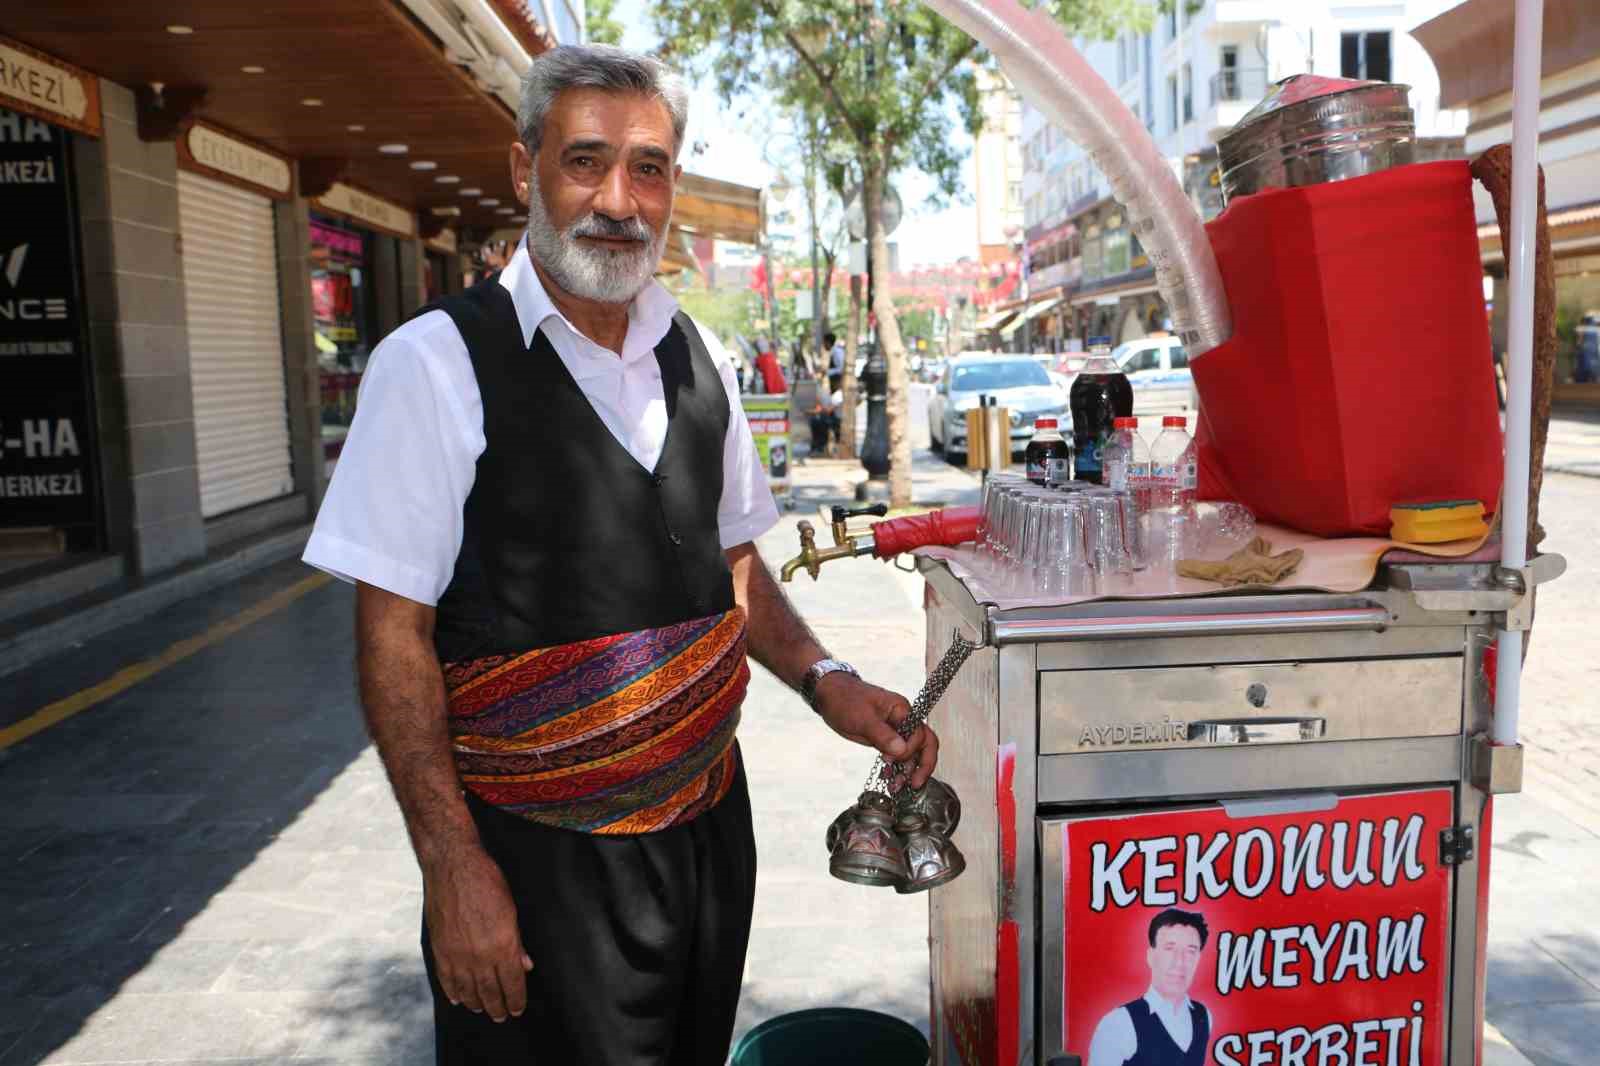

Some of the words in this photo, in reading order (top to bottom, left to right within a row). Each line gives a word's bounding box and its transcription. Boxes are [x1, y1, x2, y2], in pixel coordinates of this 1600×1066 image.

[0, 156, 55, 183] KEZİ
[0, 418, 80, 457] -HA
[1078, 714, 1186, 746] AYDEMİR
[1089, 813, 1425, 912] KEKONUN
[1215, 913, 1426, 996] MEYAM
